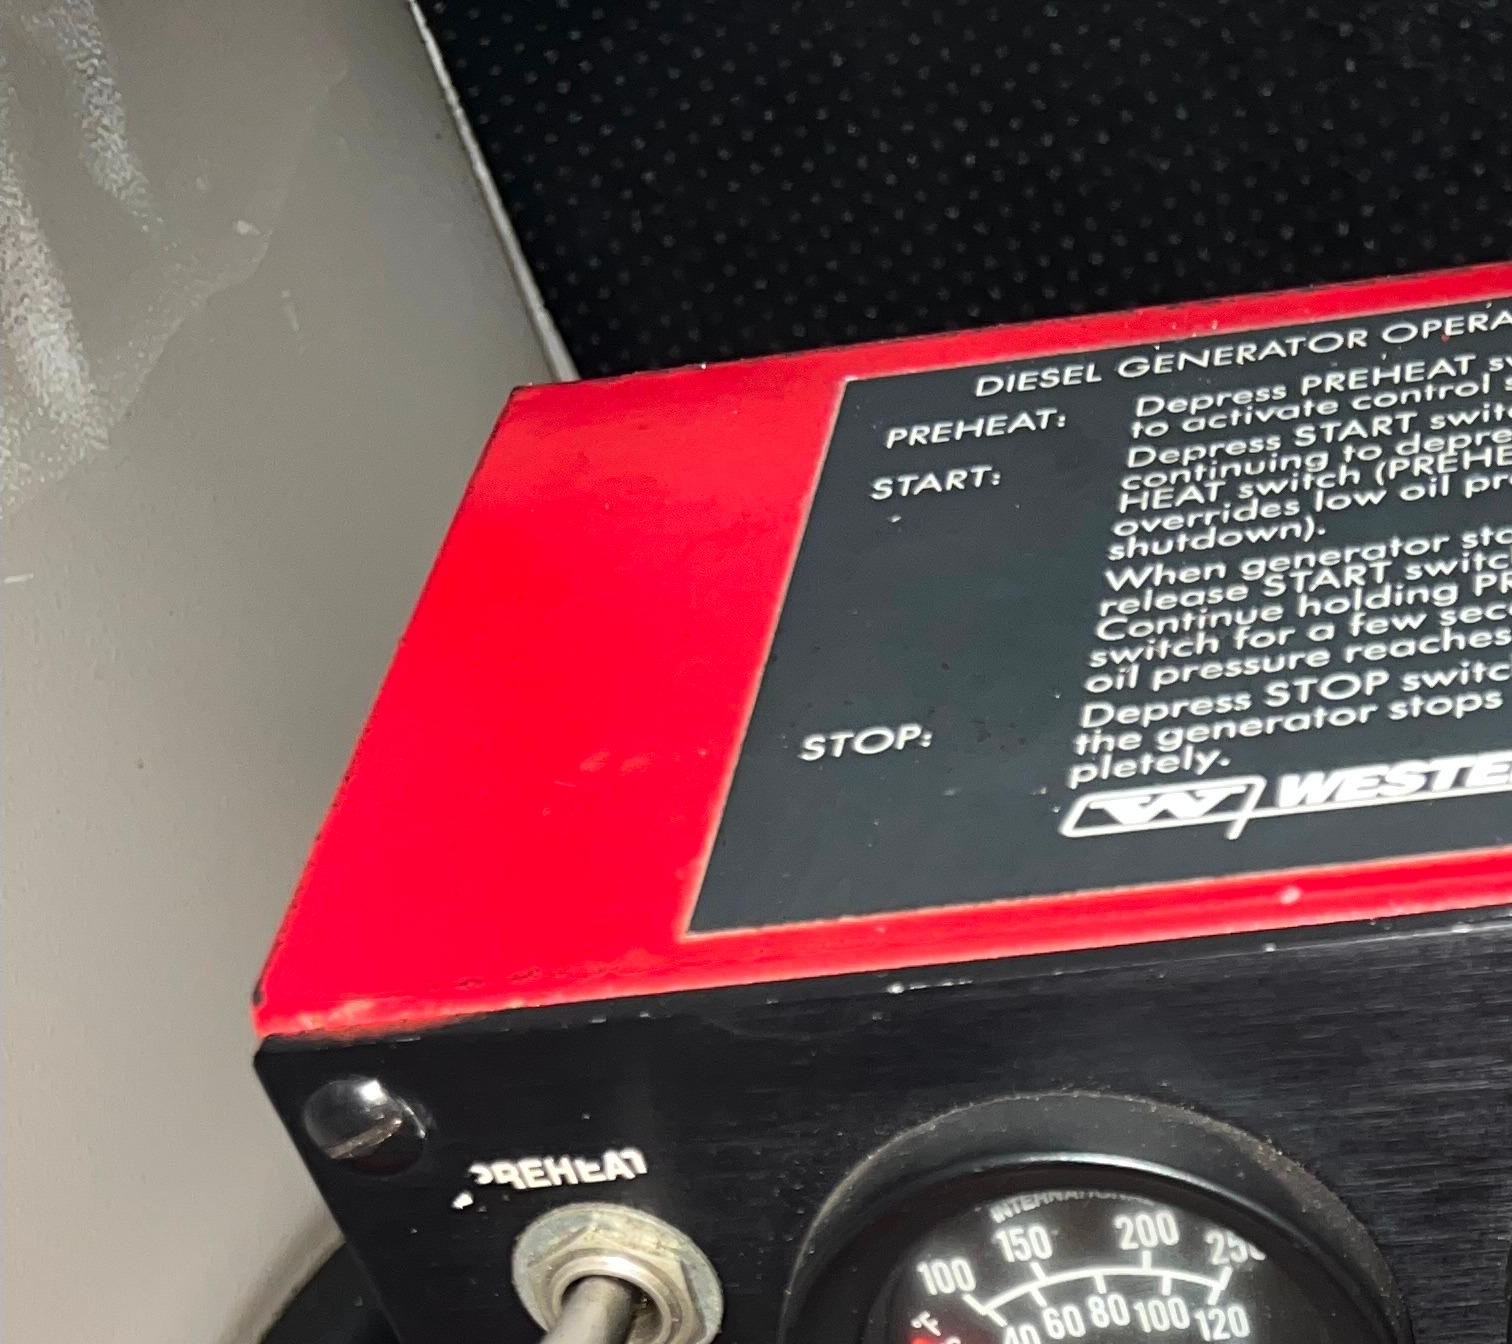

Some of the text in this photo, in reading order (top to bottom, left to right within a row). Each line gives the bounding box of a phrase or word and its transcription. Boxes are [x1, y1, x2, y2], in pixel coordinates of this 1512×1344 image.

[975, 362, 1102, 397] DIESEL
[1116, 328, 1368, 379] GENERATOR
[1135, 384, 1287, 418] Depress
[1300, 353, 1476, 396] PREHEAT
[886, 407, 1066, 449] PREHEAT:
[1131, 420, 1169, 439] to
[1182, 392, 1338, 434] activate
[1352, 373, 1490, 411] control
[1120, 454, 1329, 492] continuing
[1343, 441, 1383, 462] to
[1126, 434, 1281, 469] Depress
[1294, 412, 1418, 447] START
[870, 464, 1001, 500] START:
[1113, 498, 1301, 537] overrides
[1314, 489, 1387, 512] low
[1400, 473, 1450, 501] oil
[1119, 481, 1226, 514] HEAT
[1238, 464, 1361, 500] switch
[1104, 562, 1227, 592] When
[1240, 535, 1449, 581] generator
[1108, 514, 1326, 561] shutdown).
[1096, 604, 1284, 641] Continue
[1297, 580, 1459, 618] holding
[1099, 584, 1249, 617] release
[1263, 560, 1392, 597] START
[1084, 664, 1139, 694] oil
[1150, 648, 1330, 692] pressure
[1344, 626, 1512, 664] reaches
[1089, 631, 1220, 668] switch
[1235, 626, 1296, 650] for
[1306, 622, 1335, 642] a
[1351, 611, 1428, 636] few
[1073, 729, 1142, 756] the
[1155, 704, 1378, 752] generator
[1388, 690, 1503, 720] stops
[1080, 692, 1251, 728] Depress
[1263, 669, 1389, 707] STOP
[798, 723, 933, 761] STOP:
[1068, 746, 1231, 789] pletely.
[917, 1257, 976, 1297] 100
[994, 1225, 1054, 1262] 150
[1113, 1210, 1180, 1250] 200
[1043, 1306, 1086, 1340] 60
[1089, 1294, 1130, 1327] 80
[1134, 1298, 1190, 1333] 100
[1195, 1304, 1250, 1343] 120
